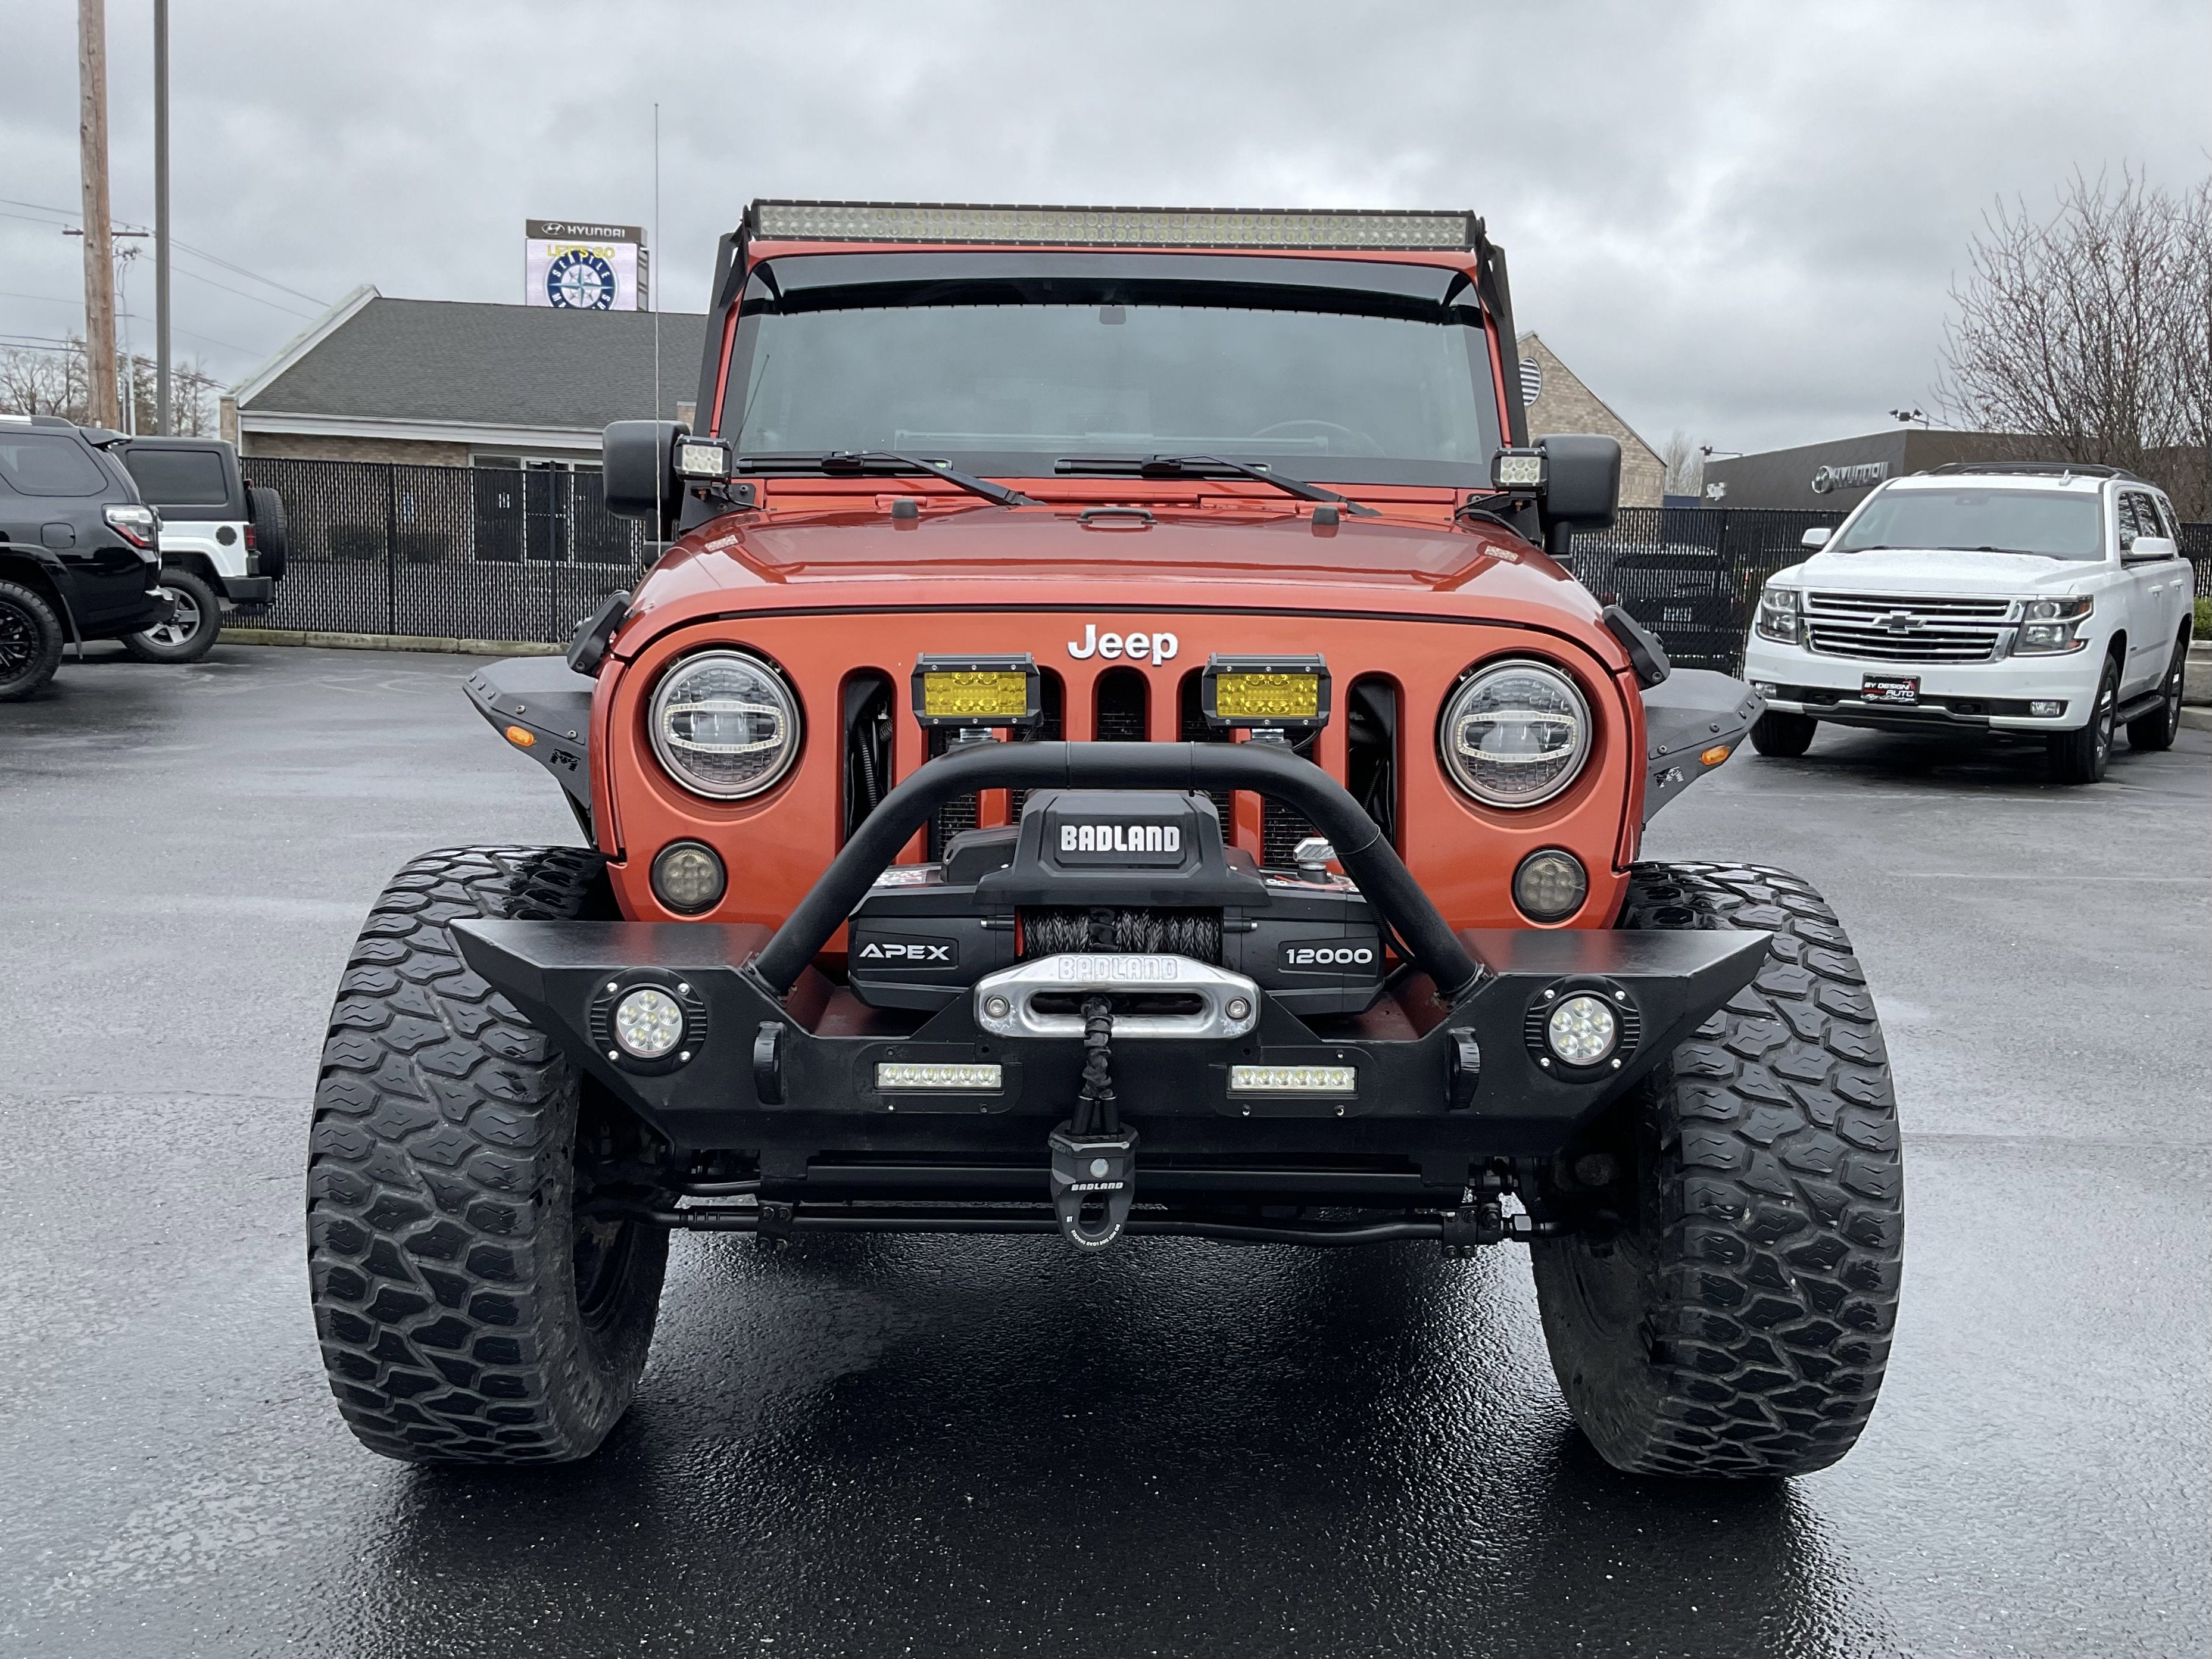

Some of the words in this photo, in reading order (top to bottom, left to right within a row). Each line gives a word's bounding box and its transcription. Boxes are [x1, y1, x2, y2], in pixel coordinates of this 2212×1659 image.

[567, 225, 625, 238] HYUNDAI
[547, 245, 589, 258] LET'S
[593, 247, 616, 260] GO
[1068, 623, 1178, 667] Jeep
[1061, 825, 1180, 852] BADLAND
[859, 943, 950, 961] APEX
[1286, 948, 1373, 964] 12000
[1059, 957, 1178, 980] BADLAND
[1071, 1182, 1124, 1191] BADLAND
